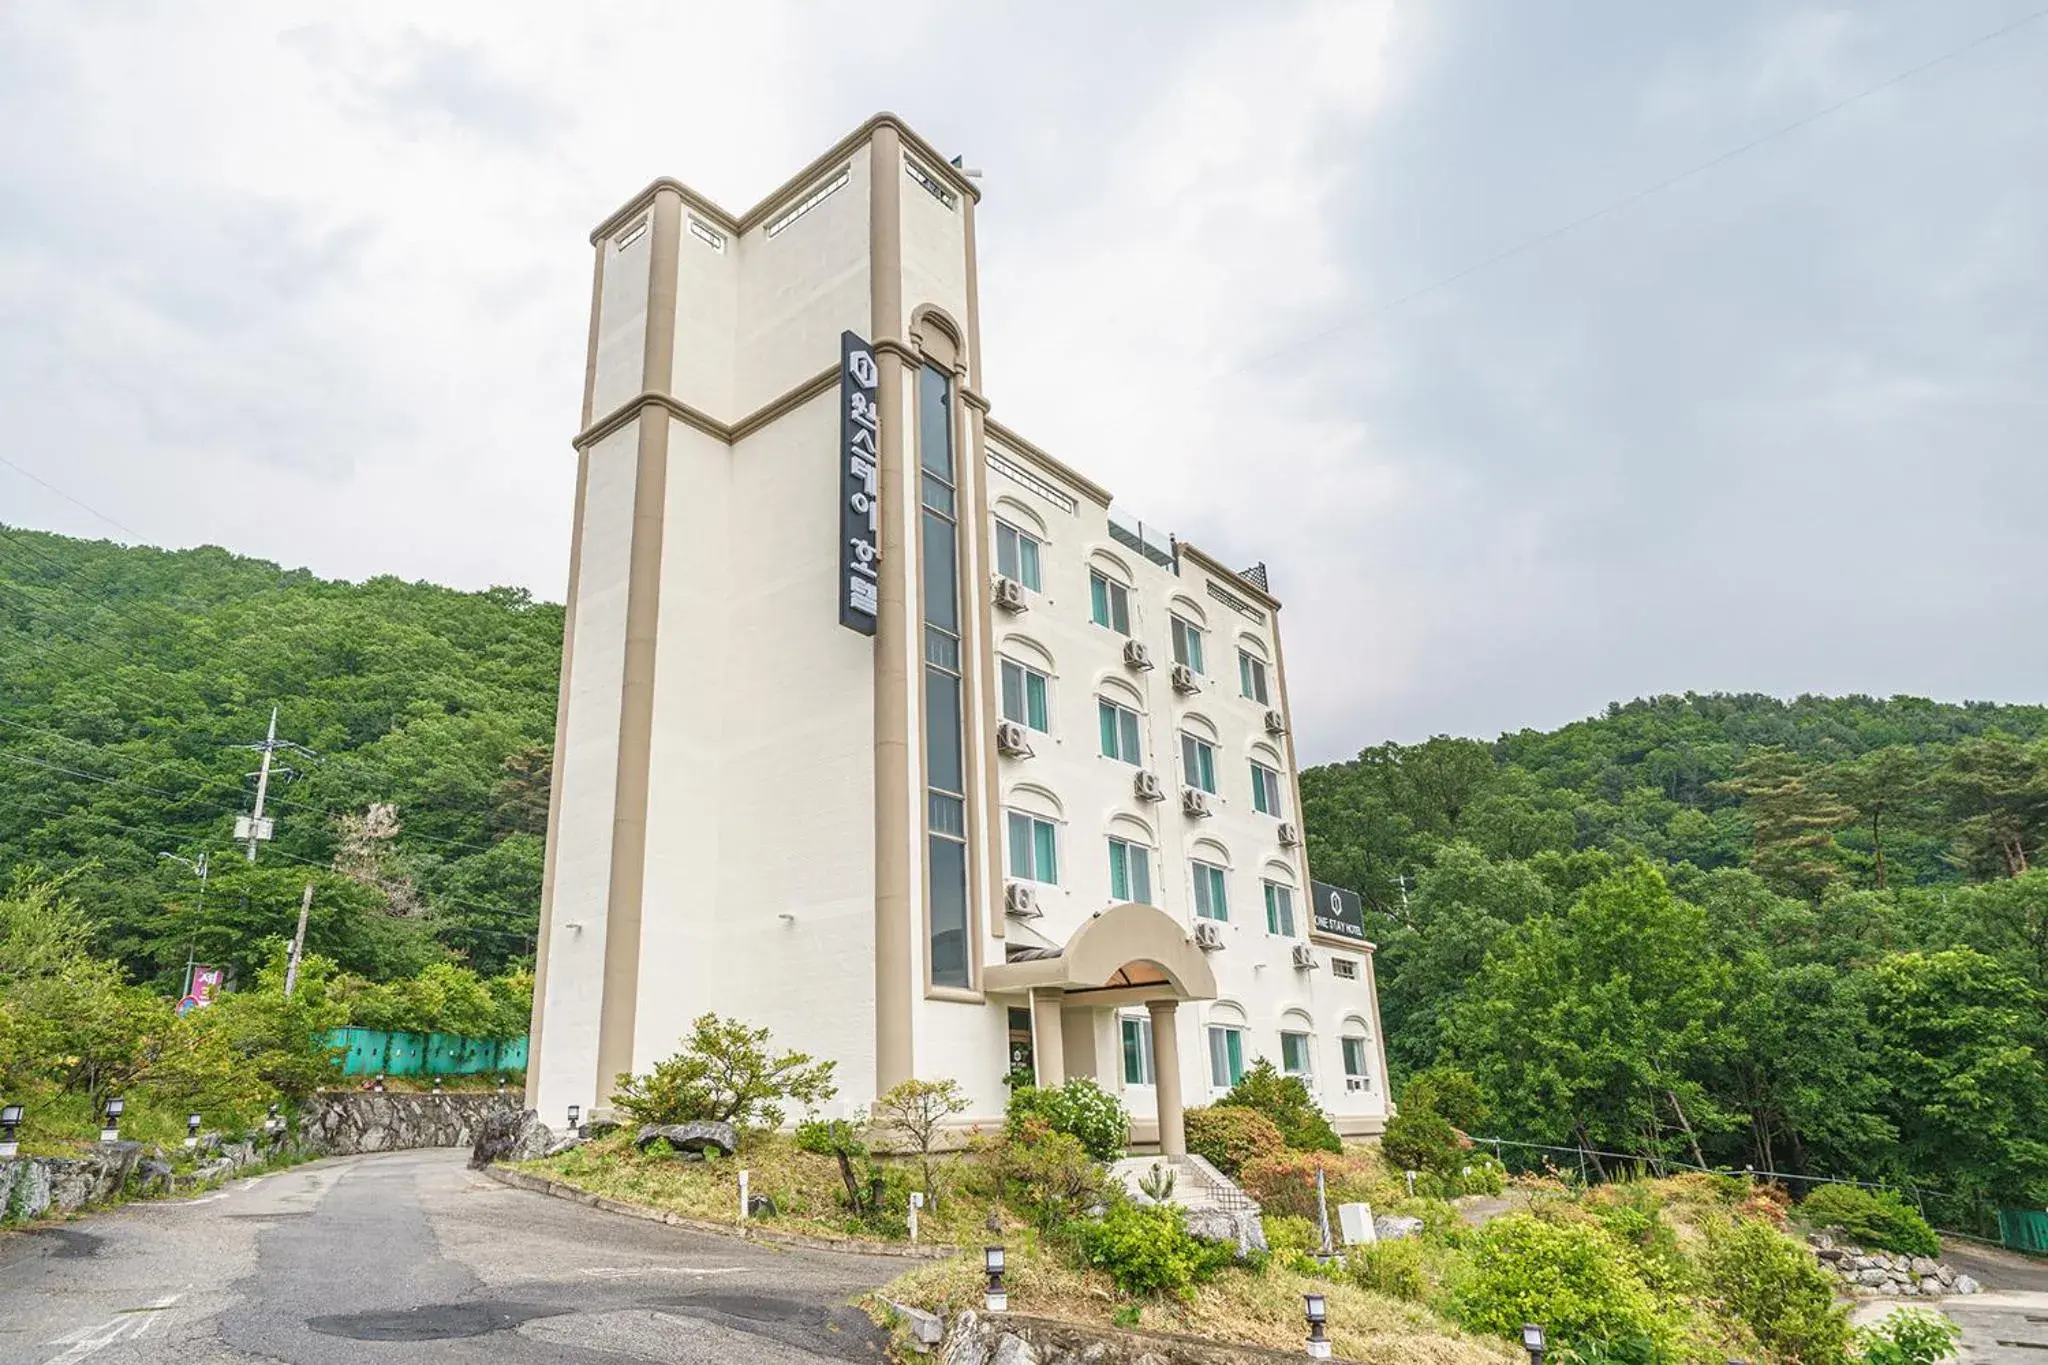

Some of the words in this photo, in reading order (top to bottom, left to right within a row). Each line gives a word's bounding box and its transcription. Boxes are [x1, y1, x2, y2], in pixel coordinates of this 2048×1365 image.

[851, 391, 877, 531] 원스테이
[850, 537, 877, 616] 호텔
[1314, 915, 1329, 929] ONE
[1329, 918, 1346, 933] STAY
[1345, 923, 1363, 936] HOTEL
